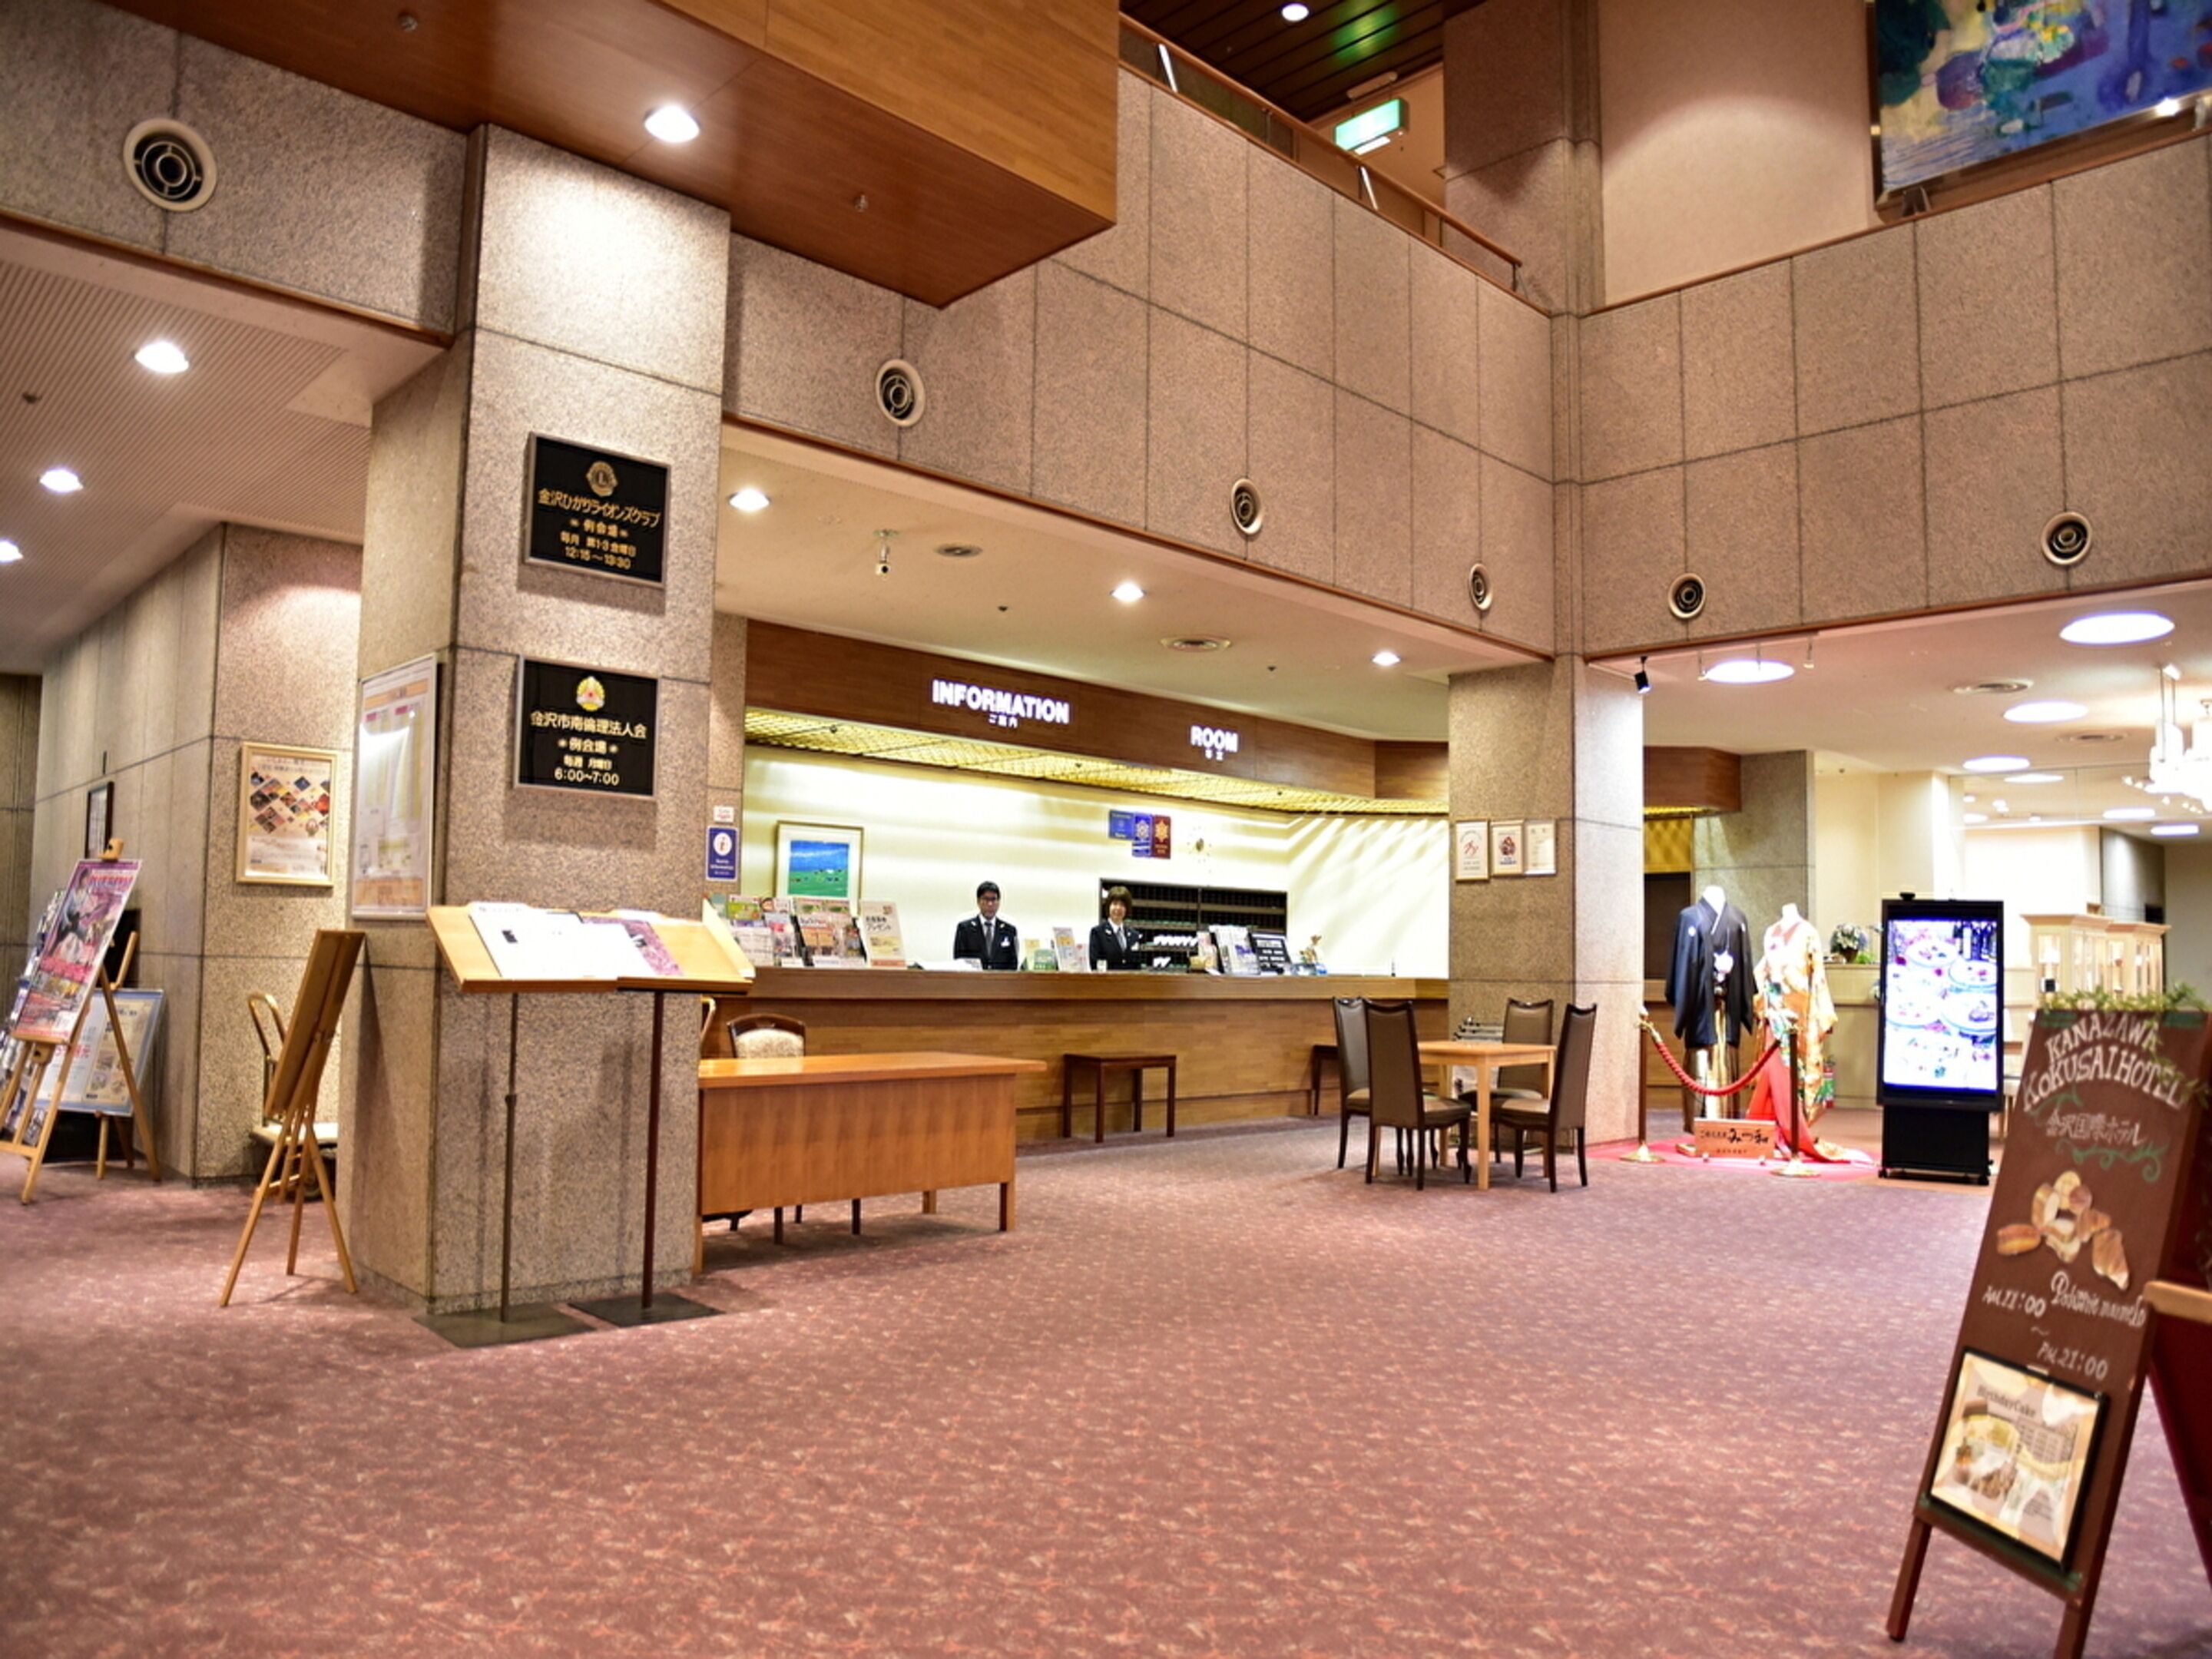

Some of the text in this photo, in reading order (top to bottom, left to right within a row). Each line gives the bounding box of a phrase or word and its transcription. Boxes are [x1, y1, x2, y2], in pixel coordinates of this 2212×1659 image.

[932, 680, 1070, 724] INFORMATION
[988, 714, 1018, 728] ご案内
[1190, 725, 1238, 753] ROOM
[2045, 1012, 2160, 1063] KANAZAWA
